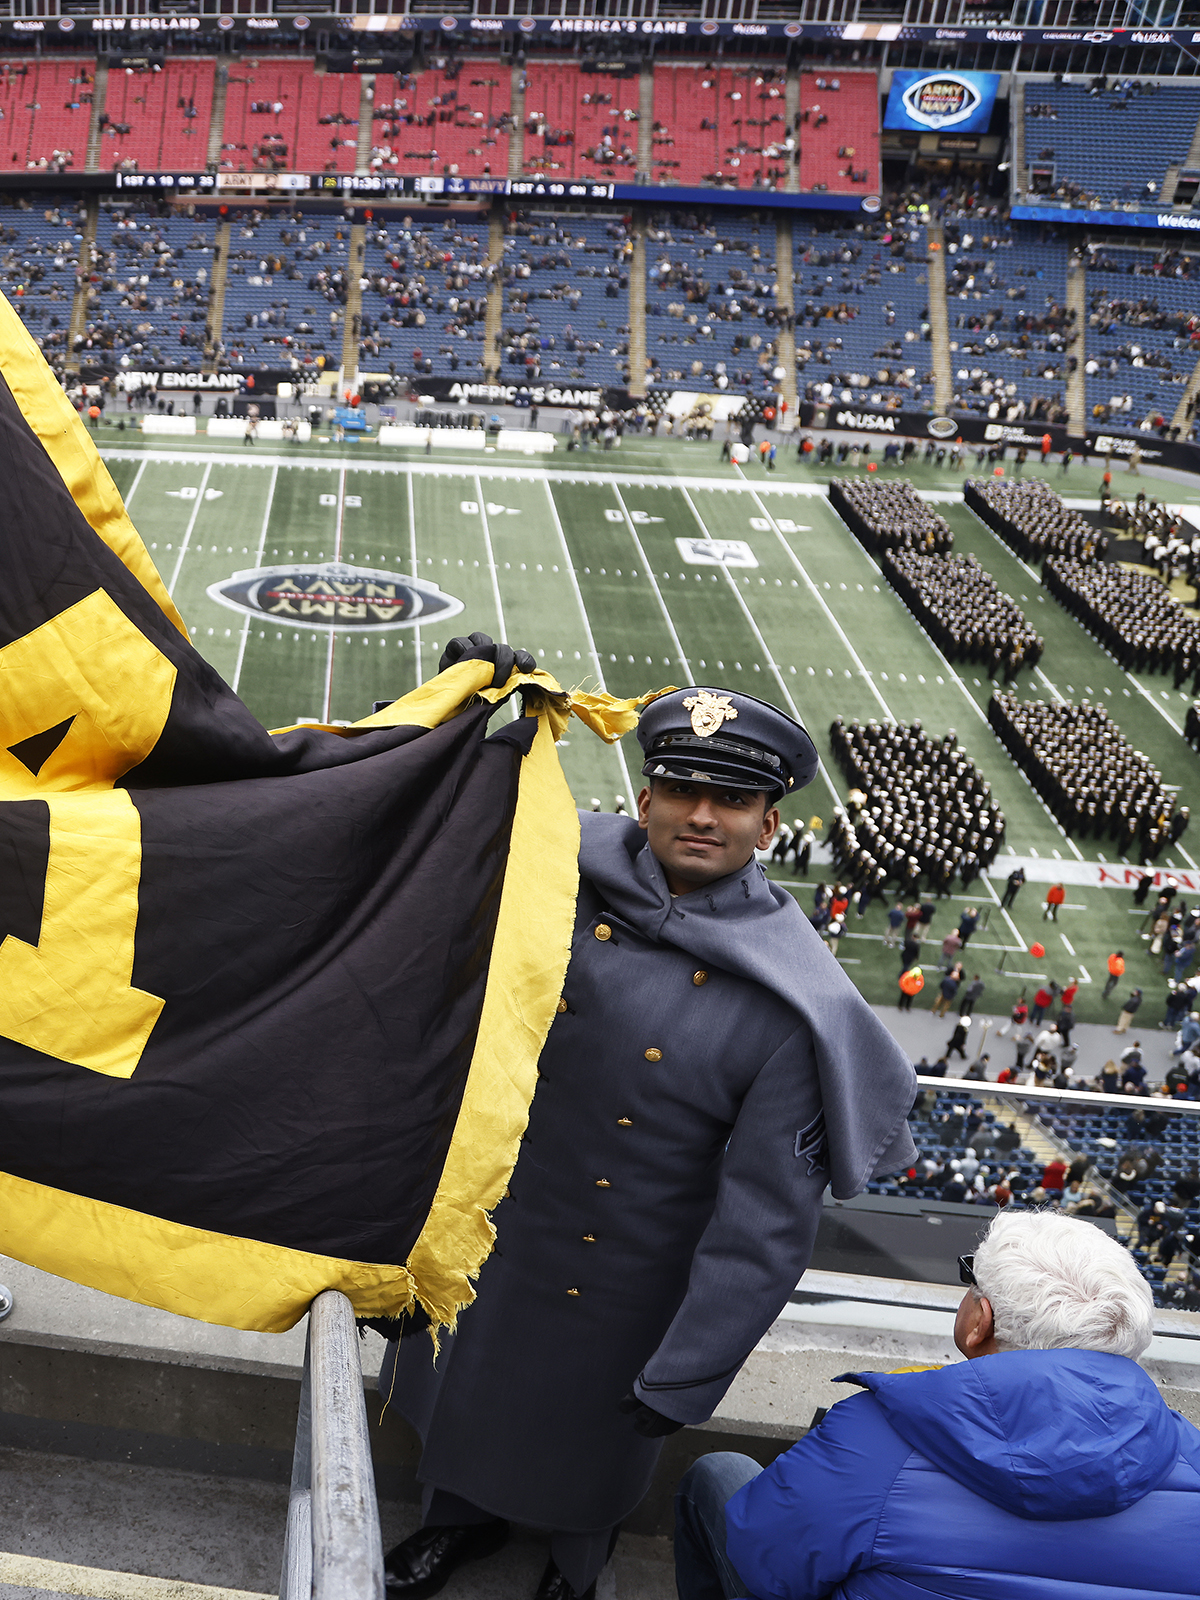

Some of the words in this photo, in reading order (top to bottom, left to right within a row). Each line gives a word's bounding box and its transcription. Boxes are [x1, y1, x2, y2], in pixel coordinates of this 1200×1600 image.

[92, 18, 125, 30] NEW
[130, 17, 200, 30] ENGLAND
[550, 19, 637, 34] AMERICA'S
[641, 20, 687, 34] GAME
[1144, 32, 1171, 43] USAA
[922, 83, 964, 96] ARMY
[920, 101, 960, 113] NAVY
[123, 175, 145, 187] 1ST
[159, 175, 174, 187] 10
[178, 175, 195, 187] ON
[200, 175, 214, 187] 35
[342, 177, 381, 190] 51:36
[469, 180, 505, 192] NAVY
[512, 182, 534, 194] 1ST
[535, 184, 545, 194] &
[549, 183, 564, 195] 10
[569, 184, 586, 196] ON
[591, 185, 607, 197] 35
[547, 388, 601, 406] GAME
[856, 414, 895, 432] USAA
[179, 486, 224, 501] 40
[319, 493, 362, 508] 50
[460, 501, 504, 515] 40
[272, 578, 396, 598] NAVY
[268, 598, 403, 620] ARMY
